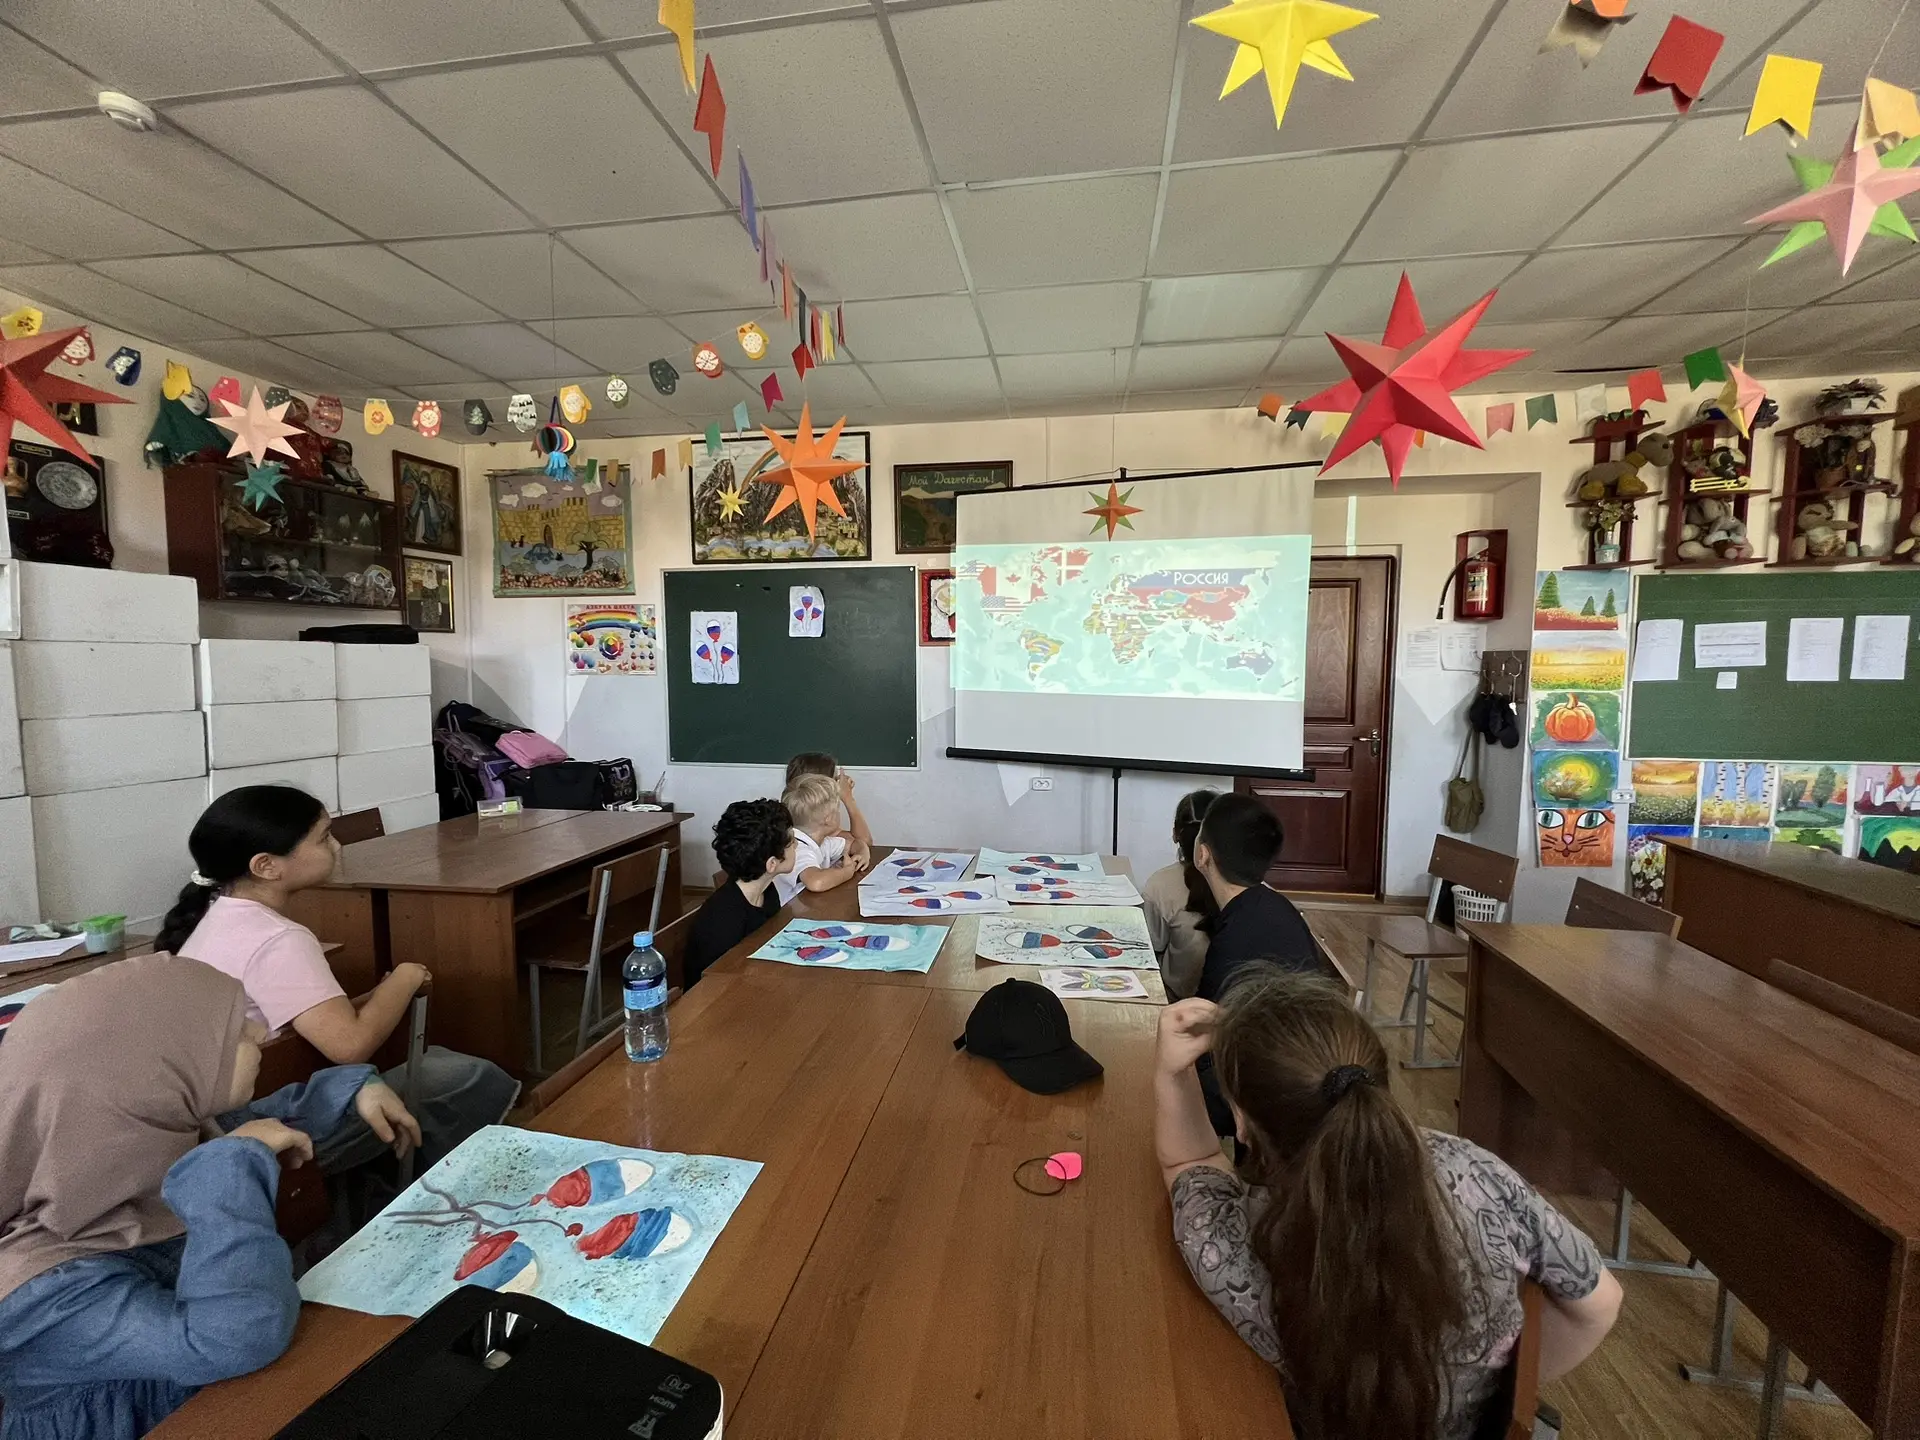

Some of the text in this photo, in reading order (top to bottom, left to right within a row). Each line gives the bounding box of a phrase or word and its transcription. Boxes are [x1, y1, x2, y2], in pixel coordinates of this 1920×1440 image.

[908, 470, 995, 487] Мой Дагестан!
[1173, 573, 1229, 585] РОССИЯ
[668, 1377, 692, 1393] DLP
